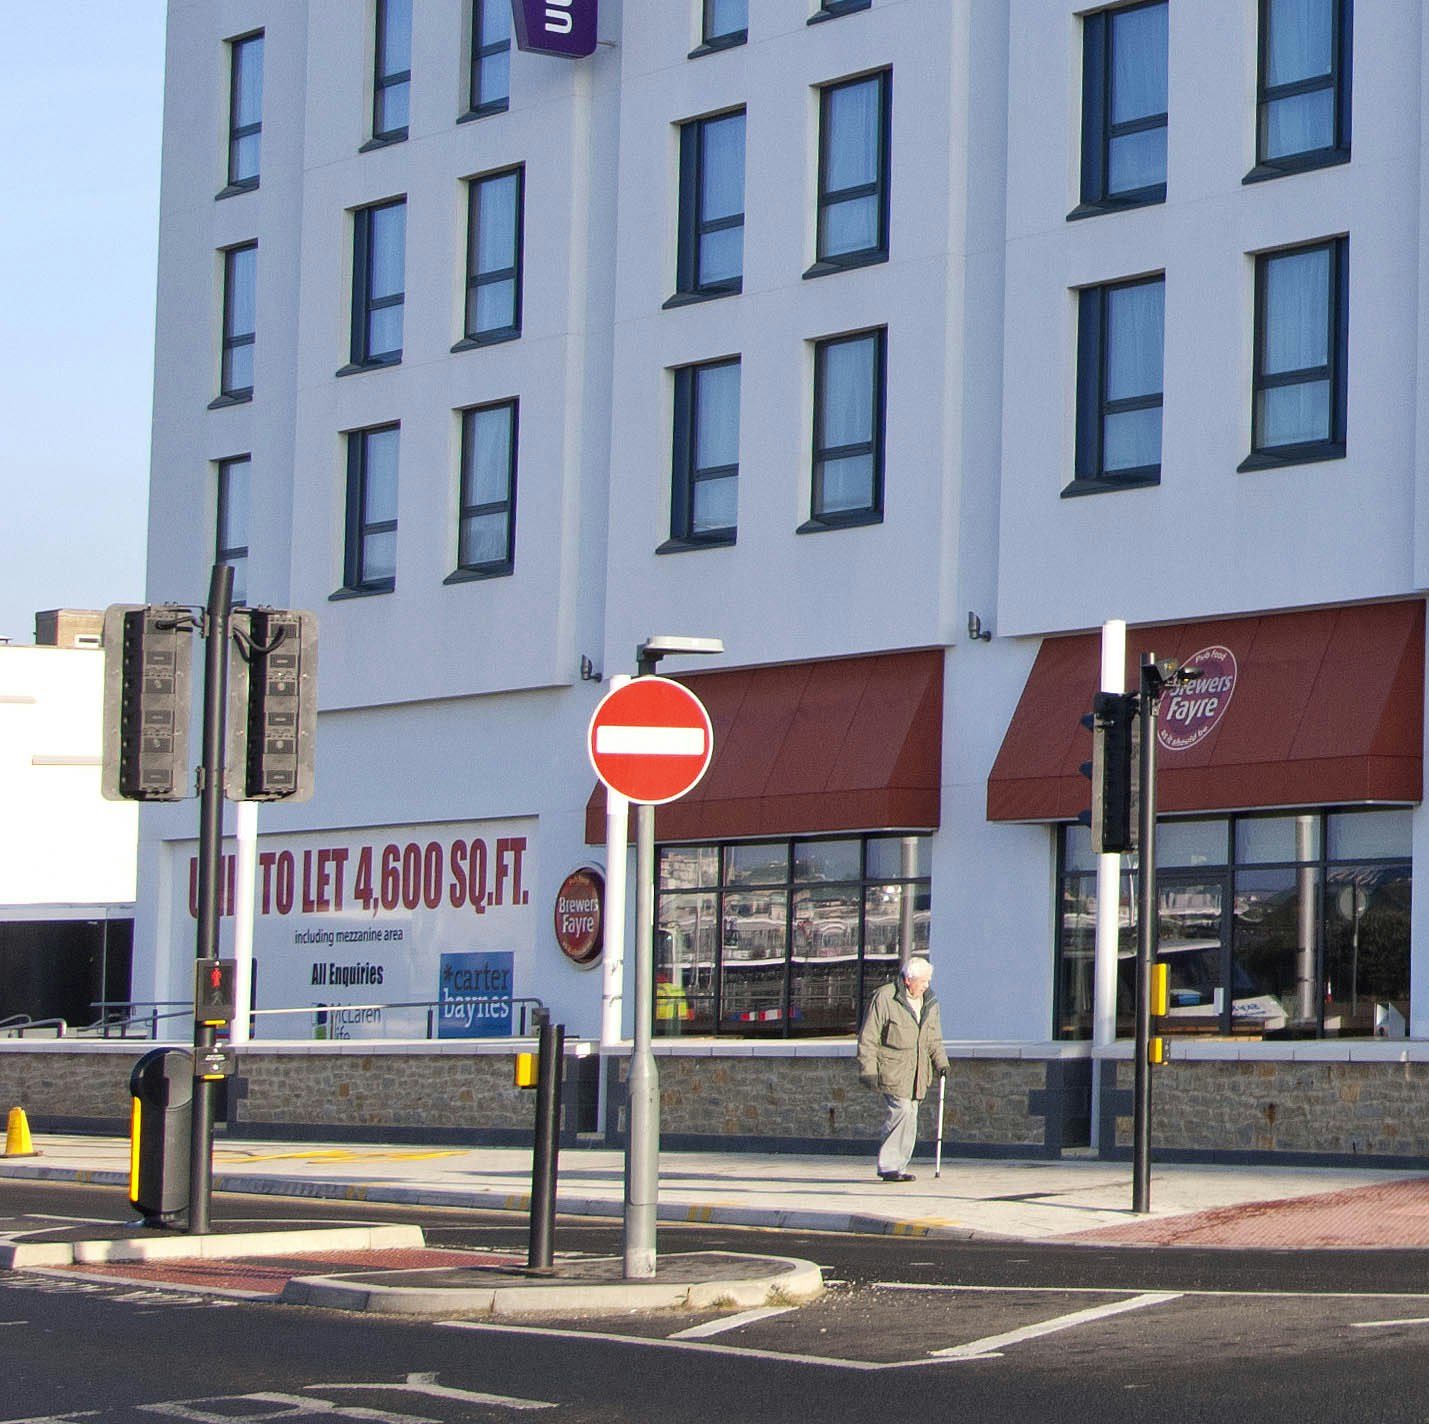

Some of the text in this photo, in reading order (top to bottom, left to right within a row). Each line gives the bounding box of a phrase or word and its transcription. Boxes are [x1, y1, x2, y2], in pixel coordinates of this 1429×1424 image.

[1166, 697, 1218, 726] Fayre
[259, 850, 295, 915] TO
[302, 848, 349, 913] LET
[354, 841, 443, 918] 4,600
[450, 837, 529, 914] SQ.FT.
[559, 896, 599, 913] Brewers
[295, 927, 404, 947] including mezzanine area
[562, 914, 594, 938] Fayre
[312, 962, 384, 987] All Enquiries
[443, 987, 510, 1028] baynes
